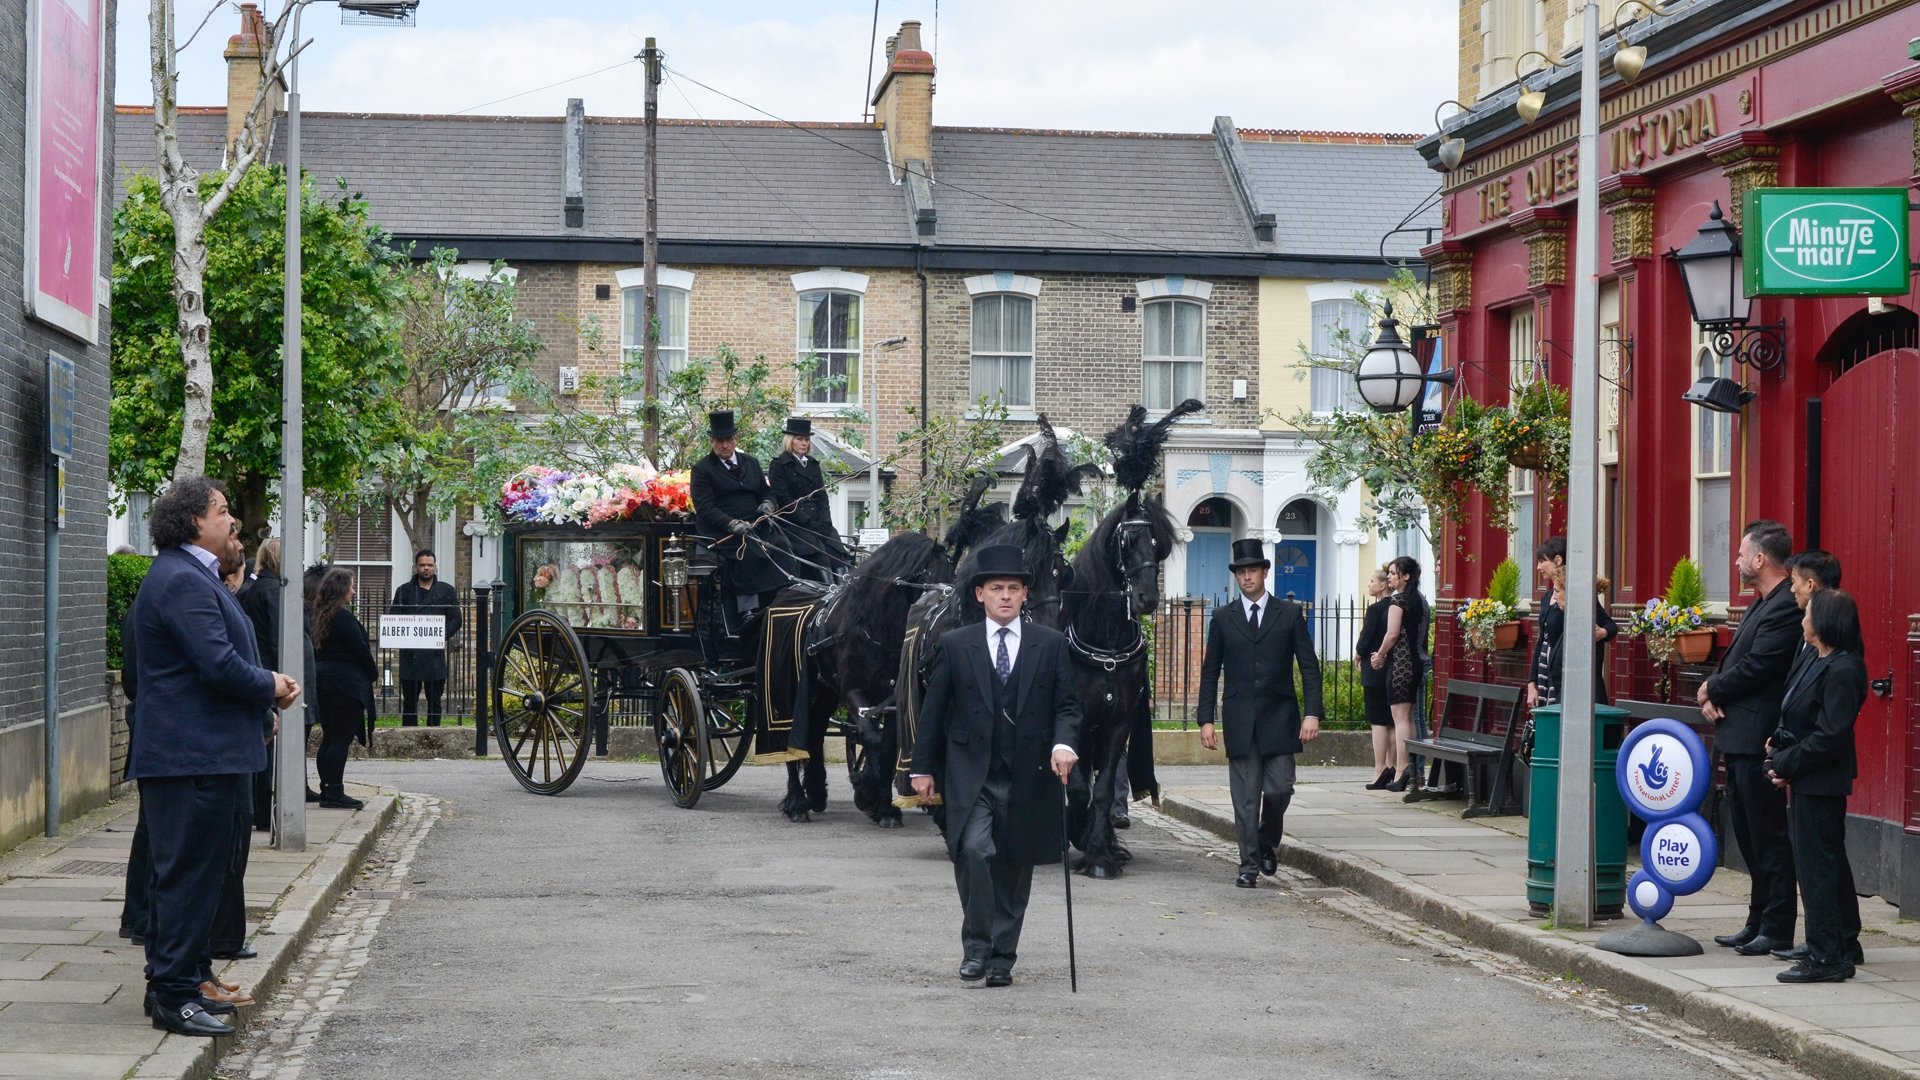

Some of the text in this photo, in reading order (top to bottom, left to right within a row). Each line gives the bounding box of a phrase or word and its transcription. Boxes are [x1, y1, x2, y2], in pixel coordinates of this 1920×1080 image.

[1477, 92, 1718, 224] THE QUEE VICTORIA
[1423, 413, 1436, 421] THE
[1285, 512, 1296, 520] 23
[1284, 565, 1294, 573] 23
[382, 626, 443, 637] ALBERT SQUARE
[1638, 785, 1666, 802] National
[1665, 771, 1681, 798] Lottery
[1659, 838, 1689, 855] Play
[1657, 852, 1690, 867] here
